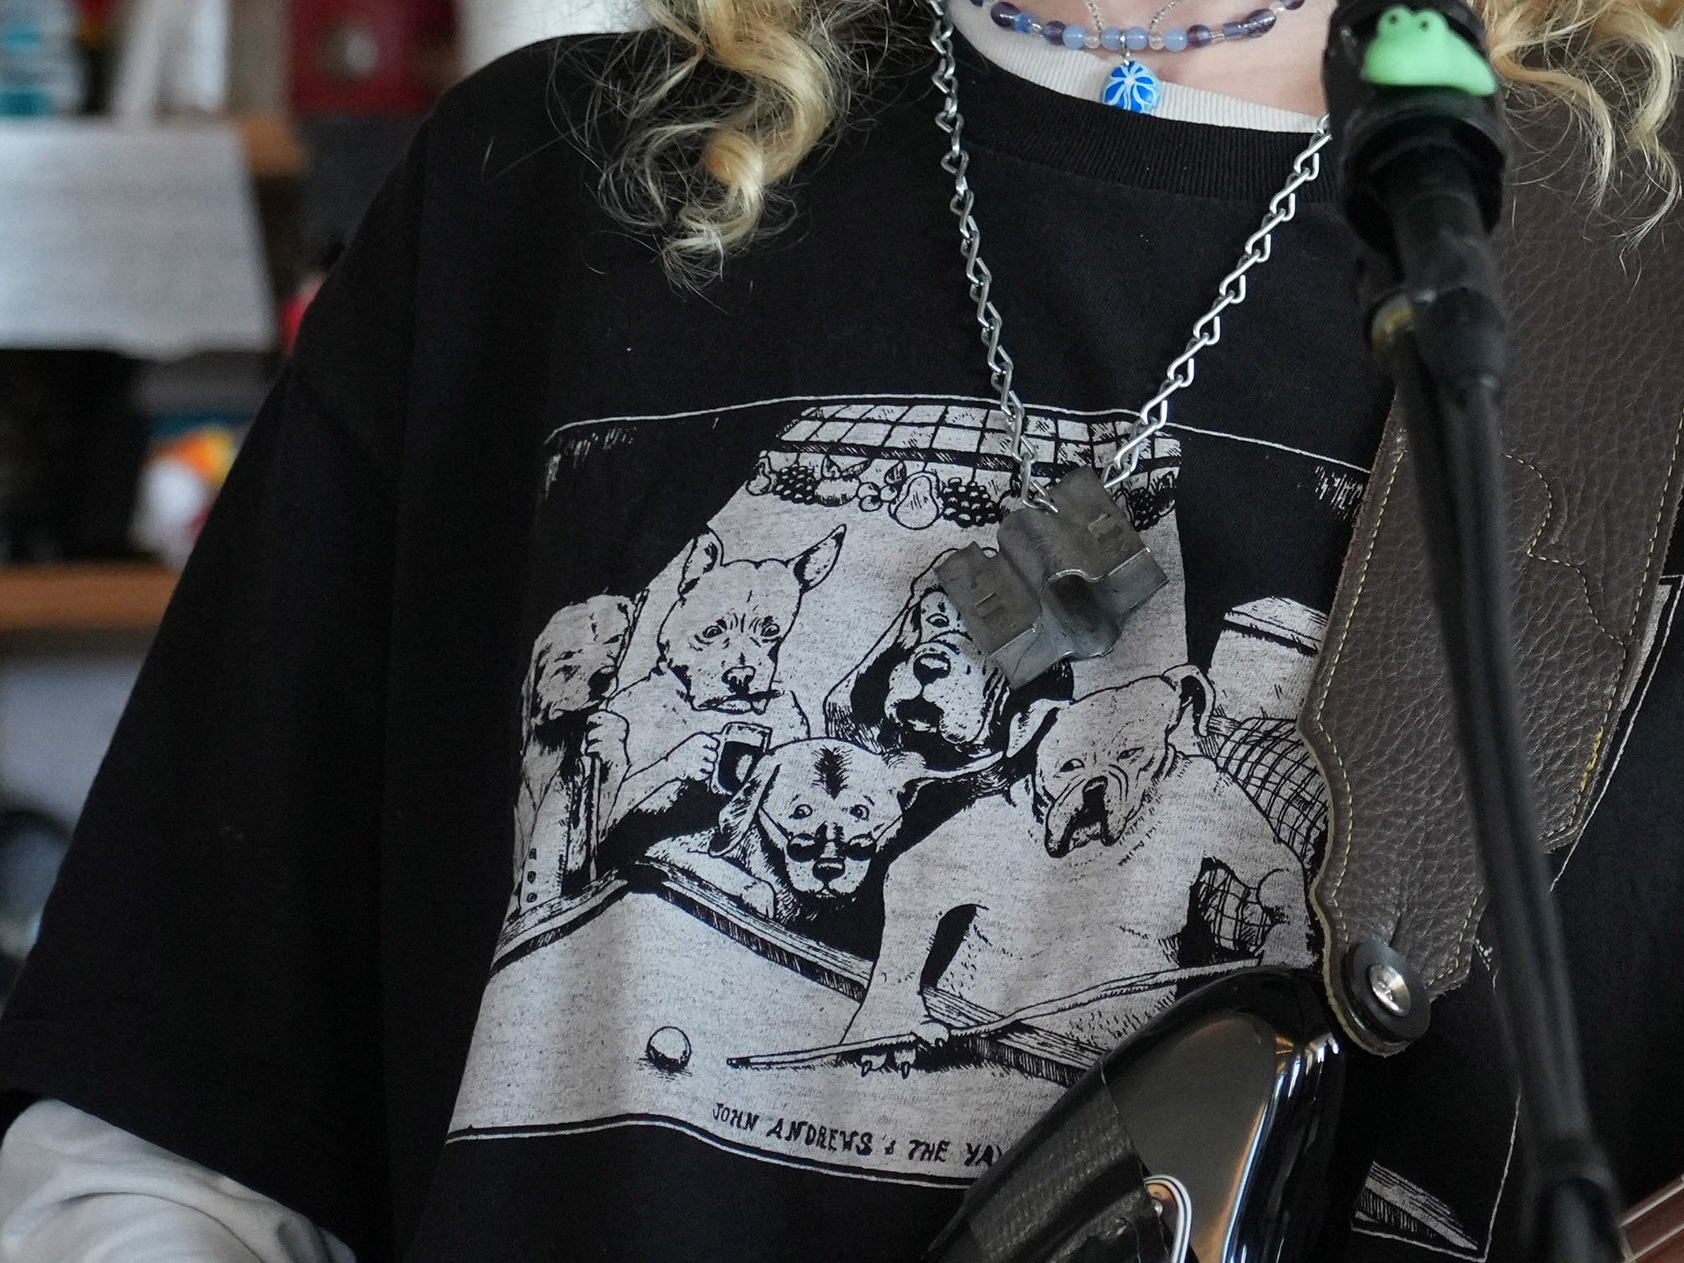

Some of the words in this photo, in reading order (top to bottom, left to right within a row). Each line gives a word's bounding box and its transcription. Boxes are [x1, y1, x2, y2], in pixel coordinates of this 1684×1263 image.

[712, 1102, 760, 1132] JOHN
[766, 1118, 873, 1156] ANDREWS
[908, 1139, 951, 1162] THE
[963, 1142, 1003, 1167] YA
